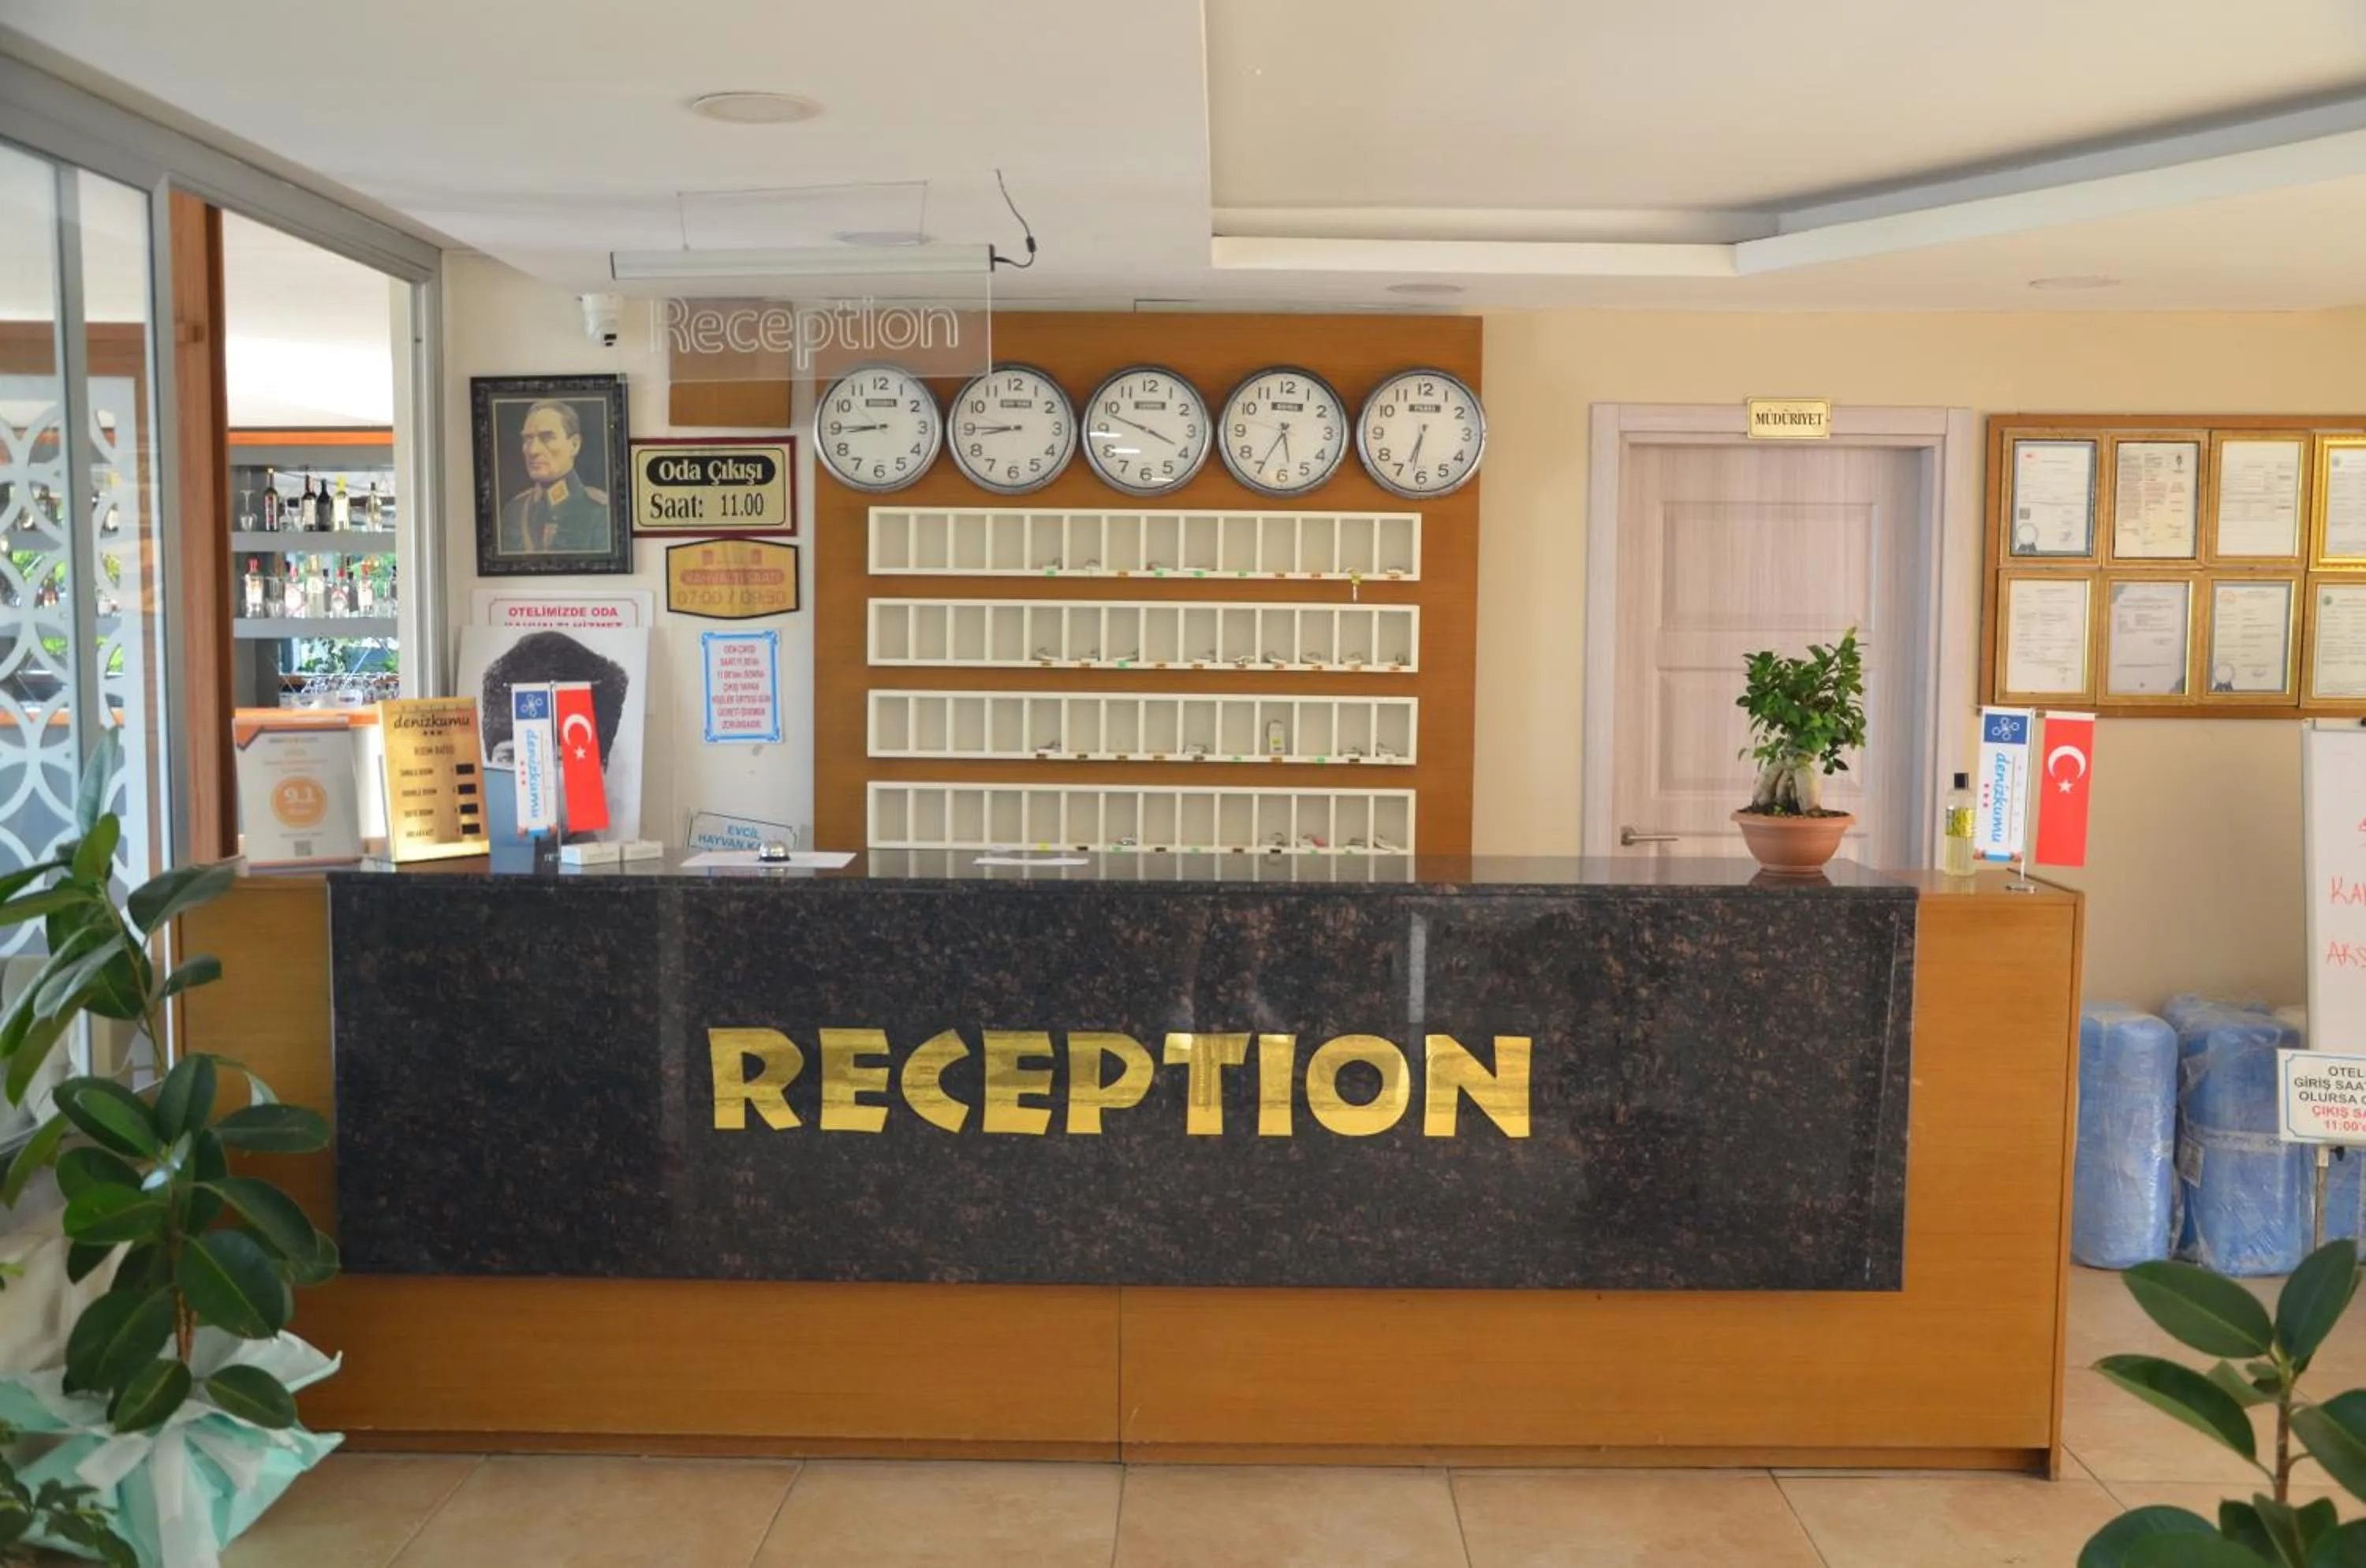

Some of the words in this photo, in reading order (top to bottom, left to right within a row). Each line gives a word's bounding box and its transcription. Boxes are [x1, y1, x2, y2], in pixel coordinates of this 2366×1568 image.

[650, 296, 959, 370] Reception
[851, 383, 863, 396] 11
[873, 377, 889, 390] 12
[1007, 379, 1023, 391] 12
[1143, 379, 1159, 393] 12
[1280, 381, 1296, 394] 12
[1418, 383, 1433, 396] 12
[986, 385, 998, 398] 11
[1121, 386, 1132, 399] 11
[1258, 386, 1270, 400] 11
[1395, 389, 1407, 402] 11
[837, 399, 851, 413] 10
[910, 400, 920, 413] 2
[970, 400, 985, 413] 10
[1044, 401, 1055, 413] 2
[1105, 401, 1120, 414] 10
[1178, 403, 1189, 416] 2
[1242, 401, 1257, 415] 10
[1316, 405, 1327, 418] 2
[1380, 405, 1394, 417] 10
[1454, 406, 1465, 420] 2
[830, 421, 842, 435] 9
[918, 420, 928, 434] 3
[964, 422, 976, 436] 9
[1051, 421, 1062, 436] 3
[1185, 424, 1196, 438] 3
[1234, 424, 1246, 437] 9
[1372, 426, 1384, 440] 9
[1323, 427, 1333, 441] 3
[1461, 427, 1472, 442] 3
[837, 442, 849, 456] 8
[910, 442, 920, 456] 4
[970, 443, 982, 457] 8
[1044, 444, 1055, 456] 4
[1178, 446, 1189, 459] 4
[1240, 446, 1252, 459] 8
[1315, 449, 1325, 461] 4
[1378, 448, 1391, 461] 8
[1454, 450, 1464, 462] 4
[851, 457, 862, 471] 7
[895, 457, 906, 471] 5
[985, 458, 996, 472] 7
[1029, 458, 1041, 472] 5
[1118, 460, 1129, 473] 7
[1162, 461, 1174, 474] 5
[1254, 461, 1264, 474] 7
[1300, 462, 1310, 476] 5
[1393, 463, 1404, 476] 7
[1438, 464, 1449, 477] 5
[659, 459, 701, 481] Oda
[707, 458, 763, 486] Çıkışı
[873, 465, 885, 478] 6
[1007, 465, 1020, 479] 6
[1140, 467, 1152, 481] 6
[1276, 469, 1288, 483] 6
[1415, 471, 1427, 484] 6
[650, 493, 703, 519] Saat:
[721, 492, 763, 517] 11.00
[509, 606, 588, 617] OTELİMİZDE
[591, 607, 618, 617] ODA
[394, 714, 471, 728] denizkumu
[526, 728, 541, 819] denizkumu
[1991, 752, 2010, 842] denizkumu
[727, 823, 760, 839] EVCİL
[698, 834, 744, 849] HAYVAN
[2328, 1066, 2364, 1078] OTEL
[707, 1027, 1531, 1138] RECEPTION
[2335, 1080, 2366, 1091] SAA
[2299, 1091, 2357, 1104] OLURSA
